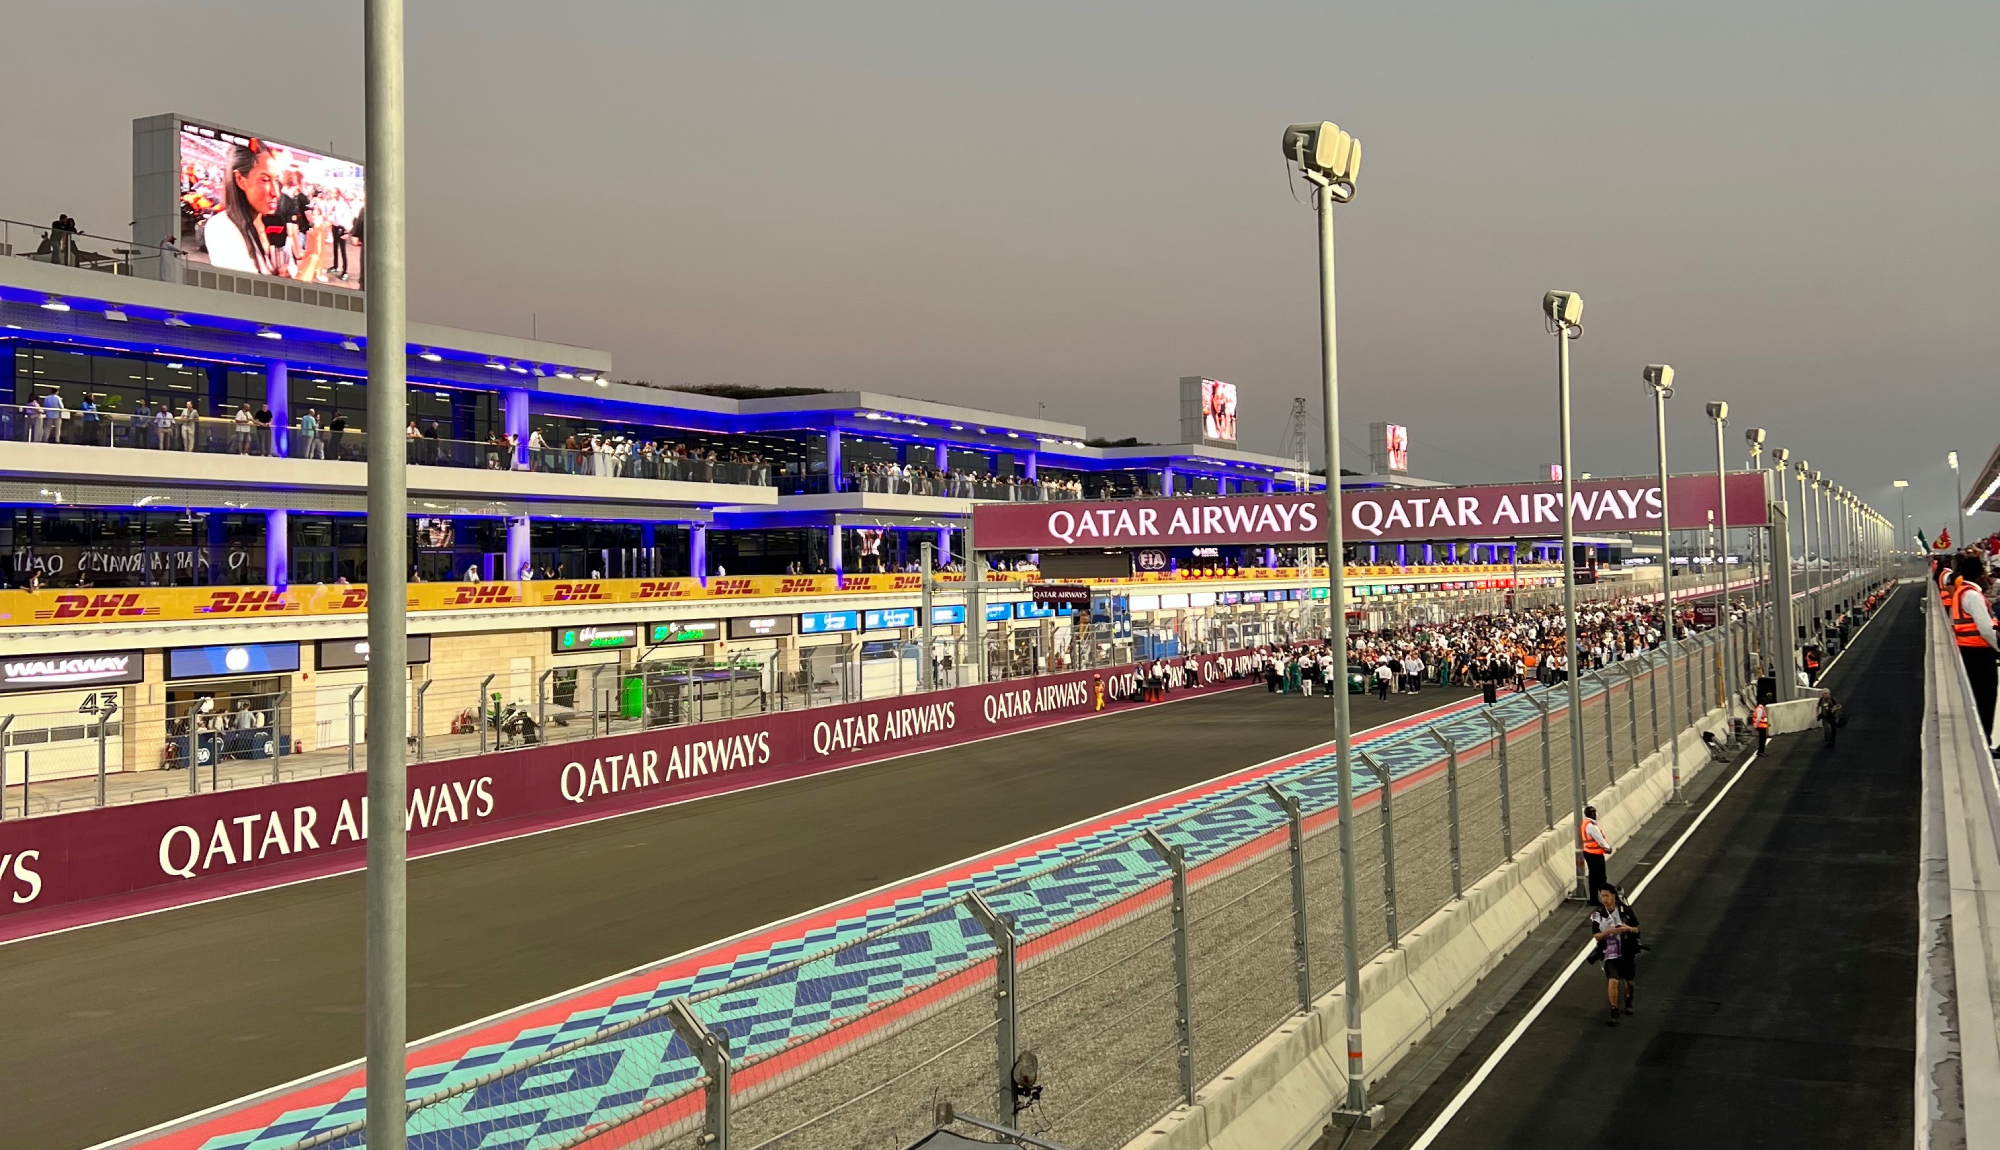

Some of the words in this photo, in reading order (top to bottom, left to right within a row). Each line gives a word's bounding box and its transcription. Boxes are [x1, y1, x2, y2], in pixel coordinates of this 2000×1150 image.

[1048, 508, 1159, 543] QATAR
[1168, 502, 1318, 536] AIRWAYS
[1351, 497, 1483, 536] QATAR
[1492, 487, 1663, 524] AIRWAYS
[455, 585, 513, 604] DHL
[553, 583, 604, 601] DHL
[639, 581, 683, 598] DHL
[714, 580, 754, 595] DHL
[781, 578, 816, 593] DHL
[841, 577, 872, 591] DHL
[1033, 591, 1057, 599] QATAR
[1058, 590, 1087, 598] AIRWAYS
[53, 594, 146, 618] DHL
[208, 590, 288, 613] DHL
[4, 655, 129, 678] WALKWAY
[79, 691, 118, 716] 43
[983, 689, 1033, 724] QATAR
[1034, 680, 1088, 713] AIRWAYS
[813, 713, 880, 756] QATAR
[883, 701, 956, 741] AIRWAYS
[560, 748, 660, 804] QATAR
[665, 730, 770, 782] AIRWAYS
[158, 804, 321, 880] QATAR
[330, 775, 496, 846] AIWAYS
